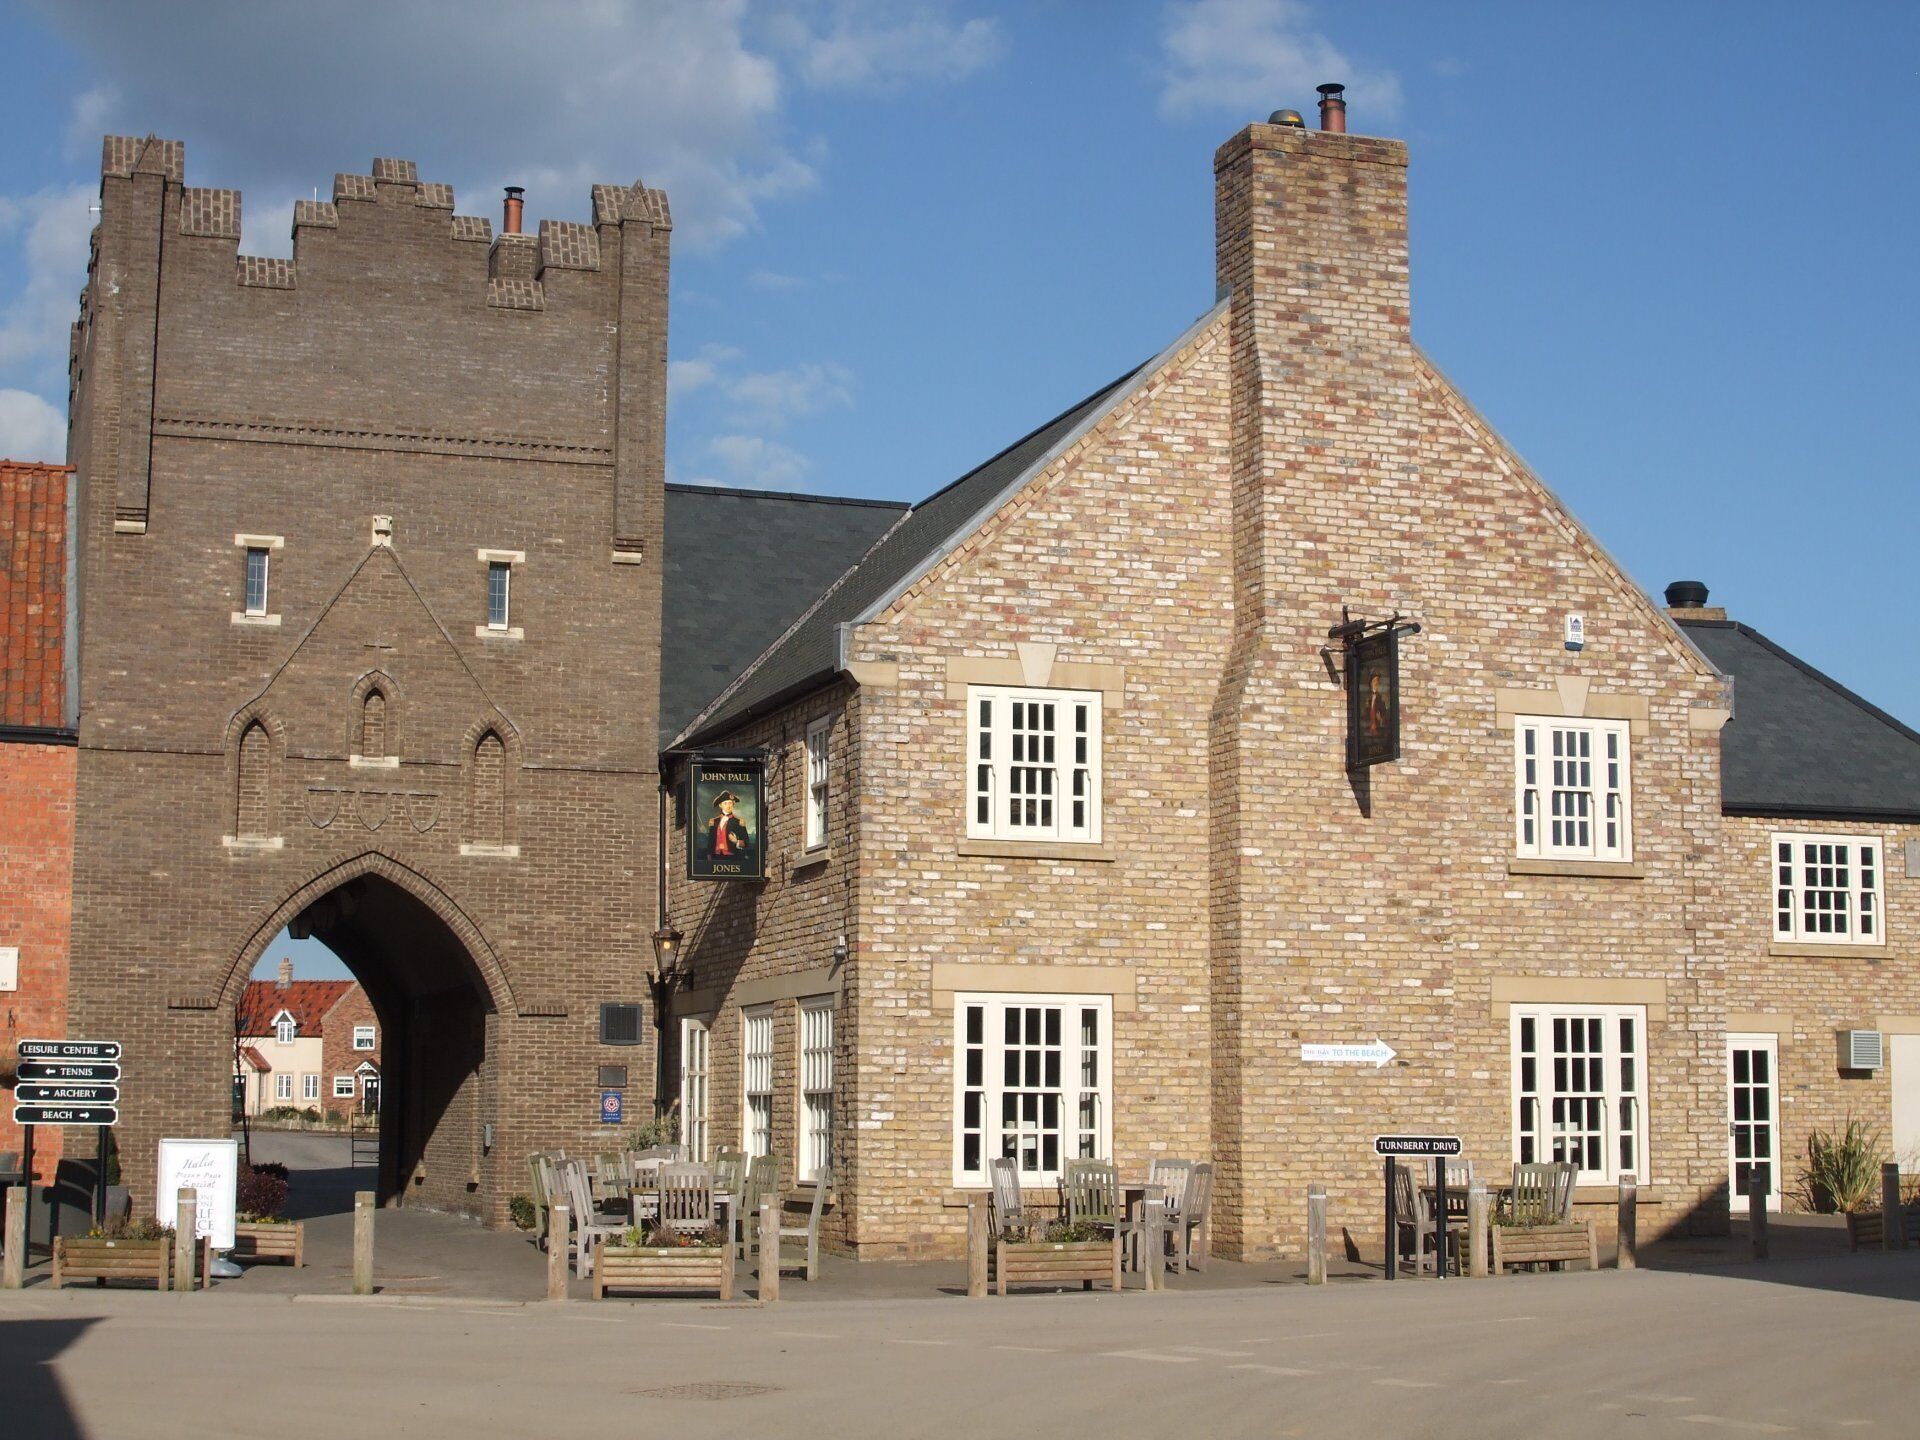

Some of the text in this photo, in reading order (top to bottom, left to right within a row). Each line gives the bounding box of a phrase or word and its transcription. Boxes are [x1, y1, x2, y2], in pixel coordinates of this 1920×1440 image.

[701, 772, 751, 782] JOHN PAUL
[712, 864, 741, 873] JONES
[23, 1045, 98, 1055] LEISURE CENTRE
[1332, 1049, 1343, 1057] TO
[1344, 1049, 1360, 1057] THE
[1361, 1049, 1387, 1057] BEACH
[60, 1067, 93, 1076] TENNIS
[54, 1089, 97, 1098] ARCHERY
[42, 1110, 73, 1119] BEACH
[1379, 1141, 1458, 1151] TURNBERRY DRIVE
